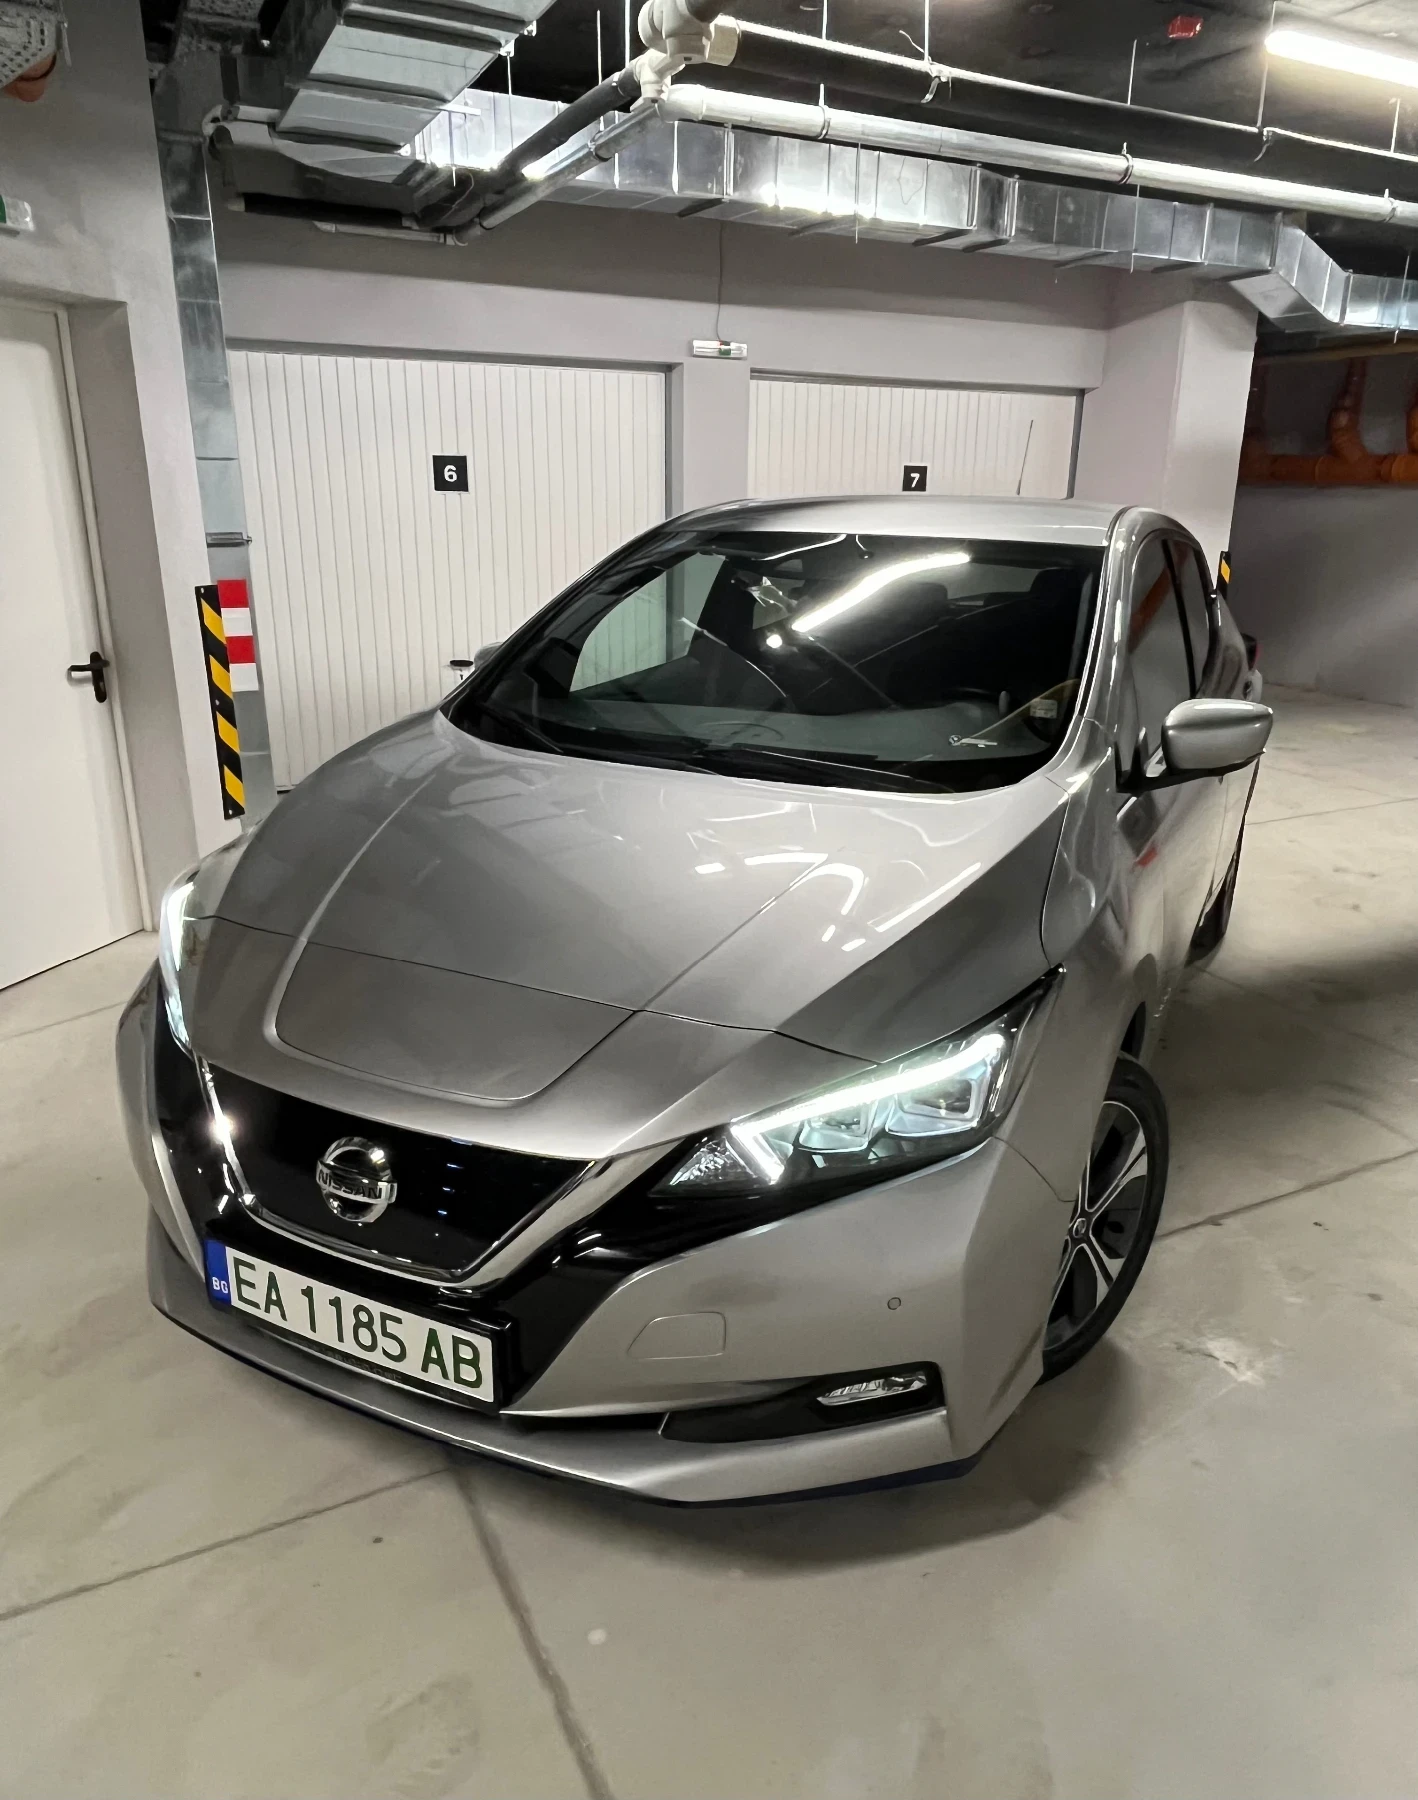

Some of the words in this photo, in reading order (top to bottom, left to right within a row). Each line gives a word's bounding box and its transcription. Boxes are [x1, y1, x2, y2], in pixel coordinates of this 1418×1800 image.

[444, 464, 458, 482] 6
[910, 472, 920, 488] 7
[212, 1276, 229, 1294] BG
[233, 1256, 288, 1322] EA
[300, 1285, 407, 1363] 1185
[420, 1327, 483, 1389] AB
